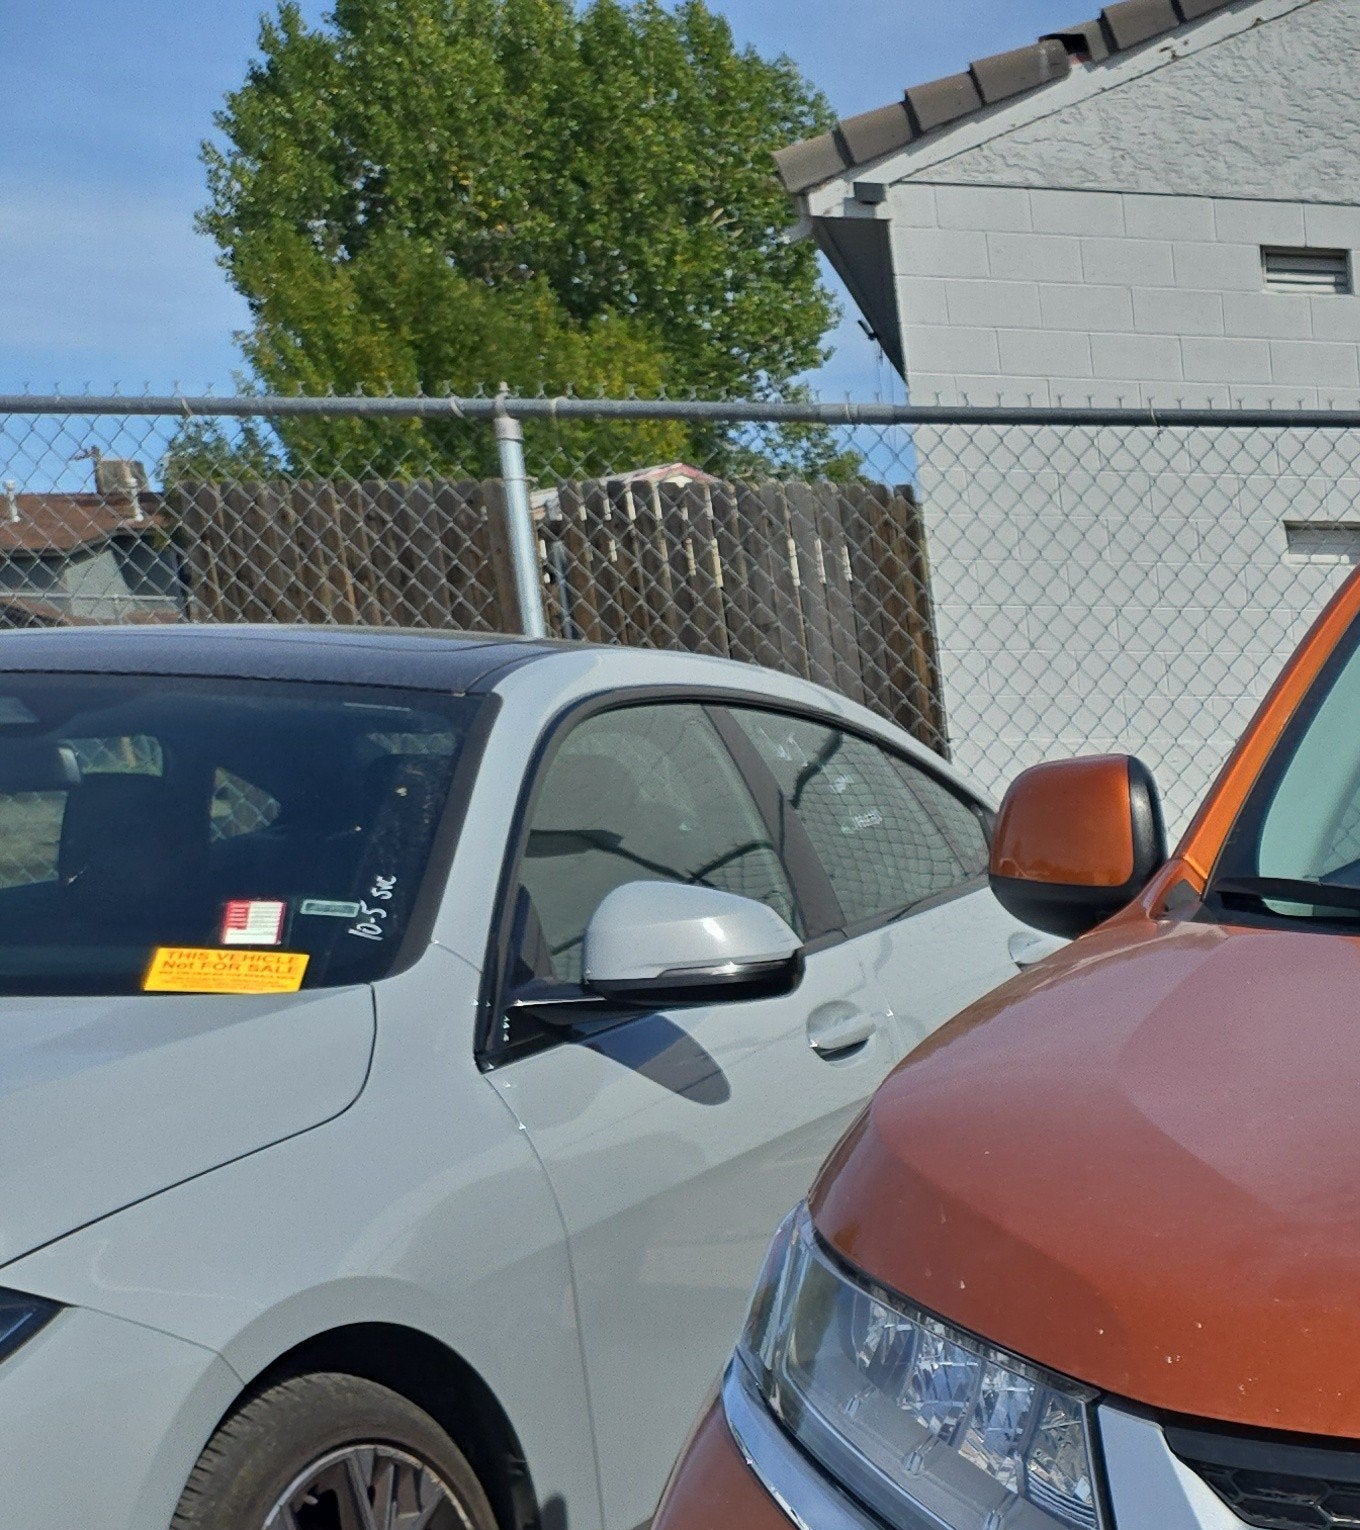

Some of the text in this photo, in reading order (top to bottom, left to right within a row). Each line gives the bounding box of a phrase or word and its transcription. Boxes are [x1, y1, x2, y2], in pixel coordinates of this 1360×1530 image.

[167, 951, 299, 964] THIS VEHICLE
[163, 960, 295, 974] Not FOR SALE
